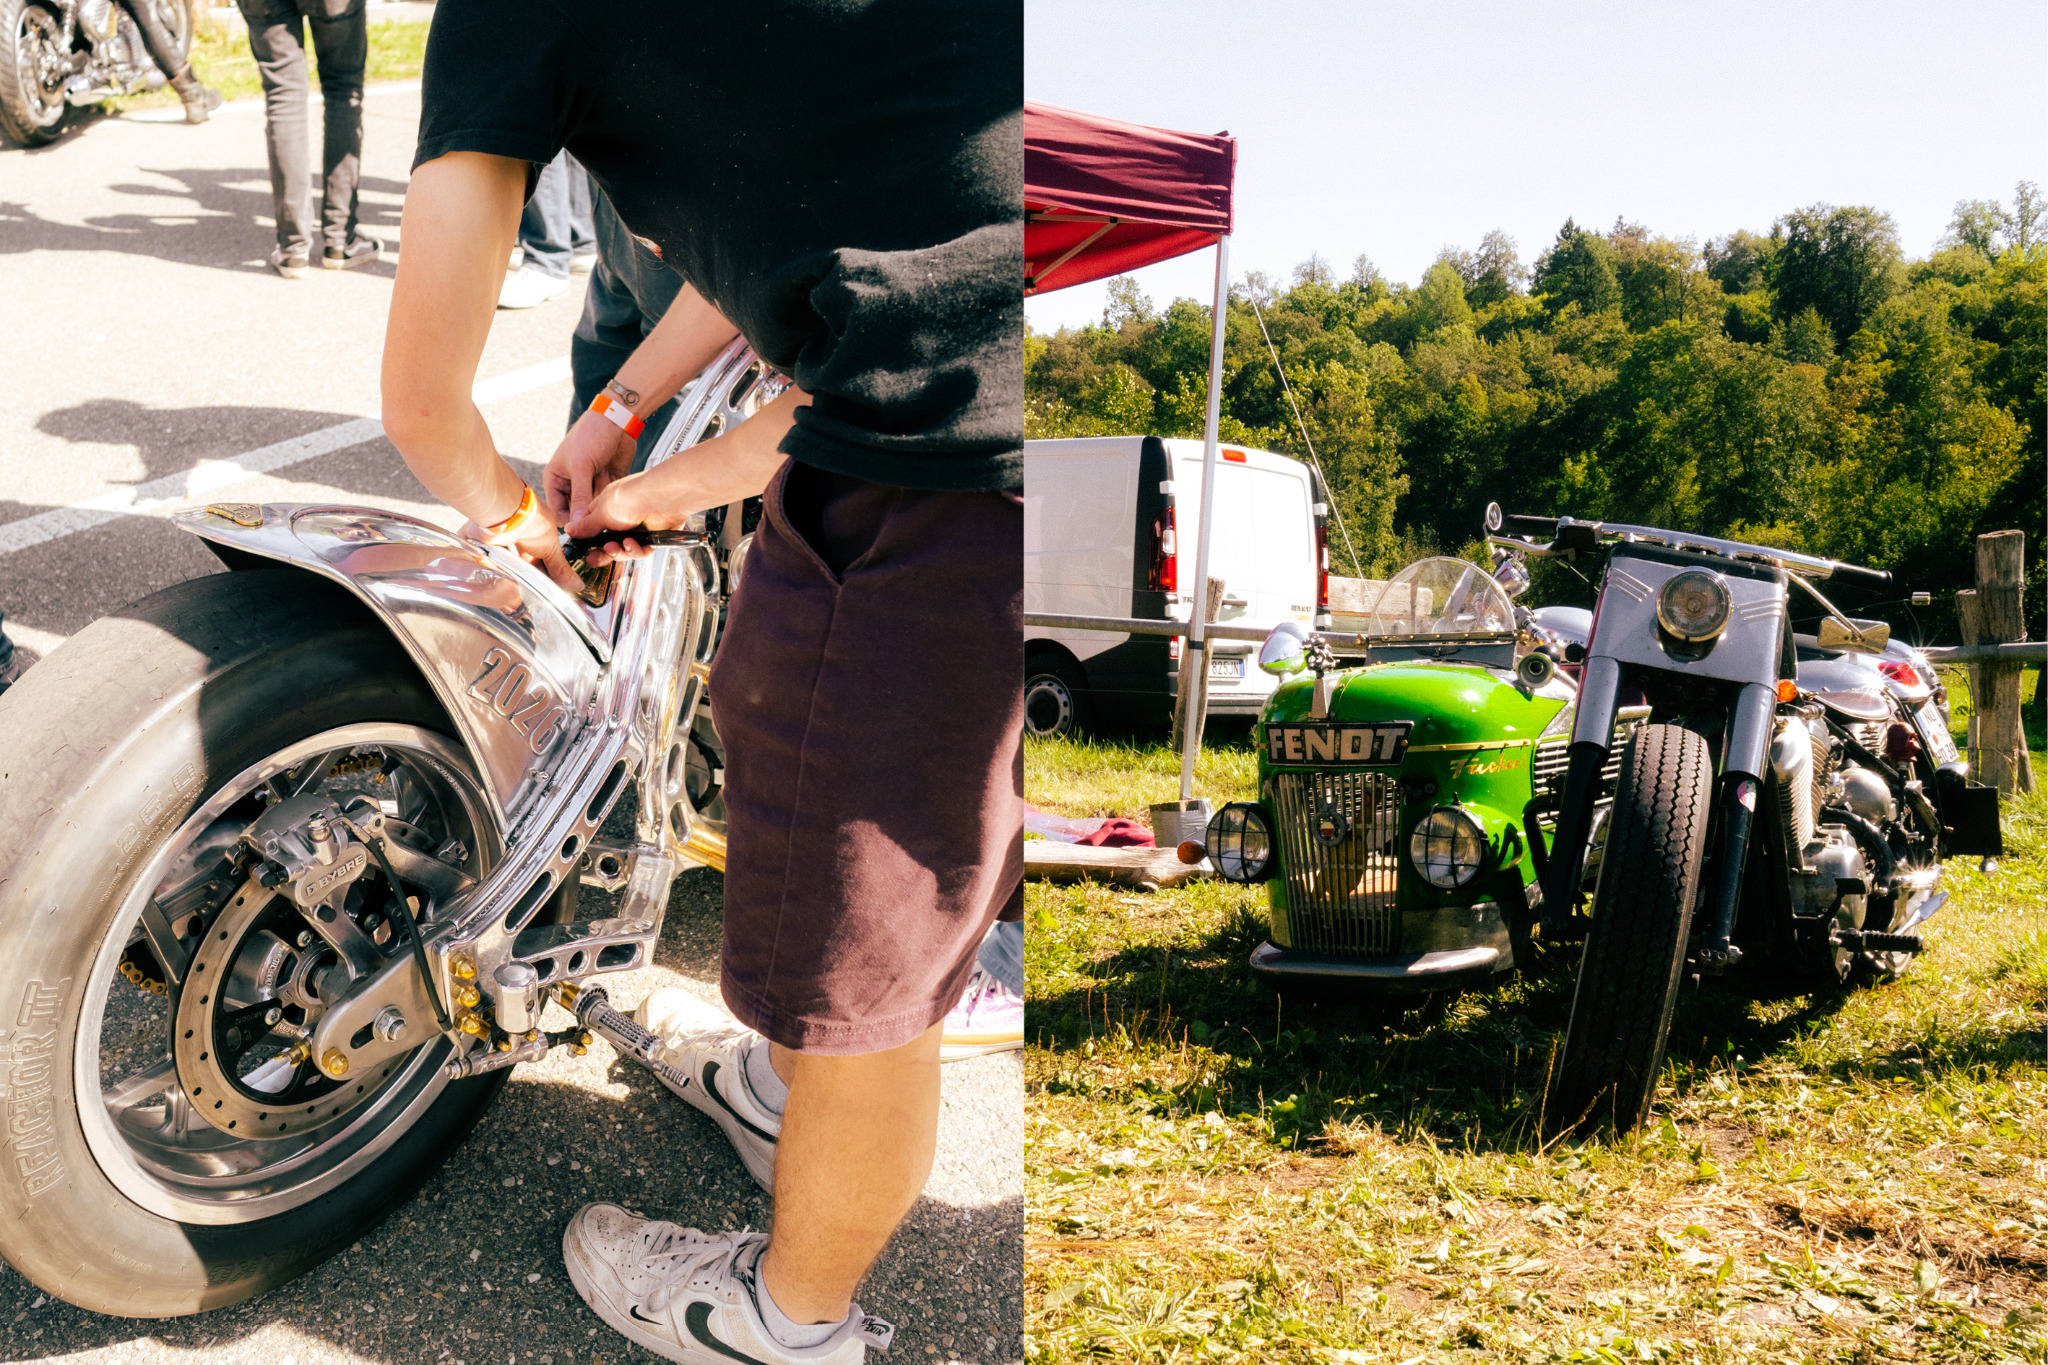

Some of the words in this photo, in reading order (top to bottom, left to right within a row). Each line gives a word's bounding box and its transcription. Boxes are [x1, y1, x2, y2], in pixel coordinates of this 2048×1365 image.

[467, 647, 568, 755] 2026
[1268, 728, 1406, 761] FENDT
[319, 854, 363, 889] BYBRE
[8, 1030, 64, 1197] REACTOR
[864, 1325, 884, 1336] NIKE
